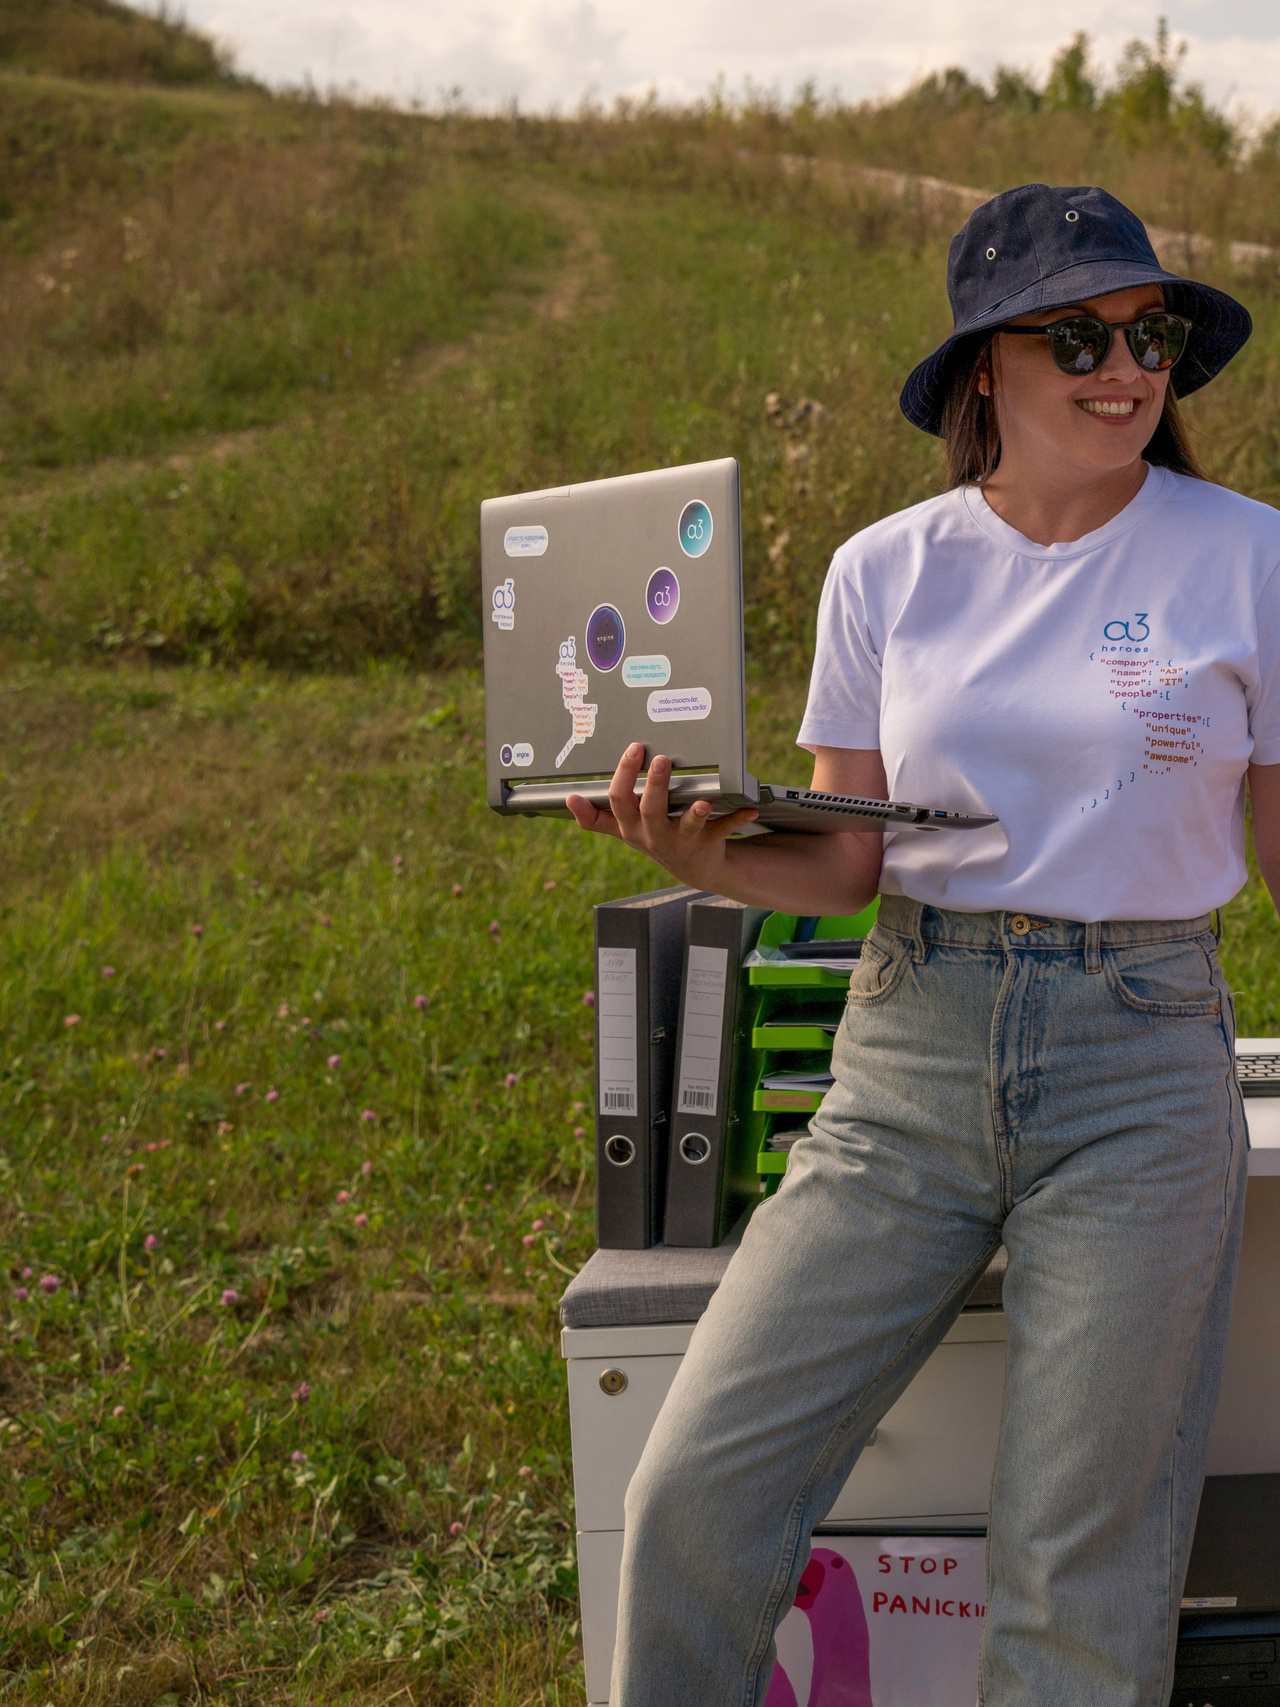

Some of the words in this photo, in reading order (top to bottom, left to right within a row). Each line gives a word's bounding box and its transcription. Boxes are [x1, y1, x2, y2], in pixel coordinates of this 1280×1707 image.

[1103, 612, 1150, 642] a3
[1101, 645, 1149, 653] heroes
[877, 1554, 958, 1575] STOP
